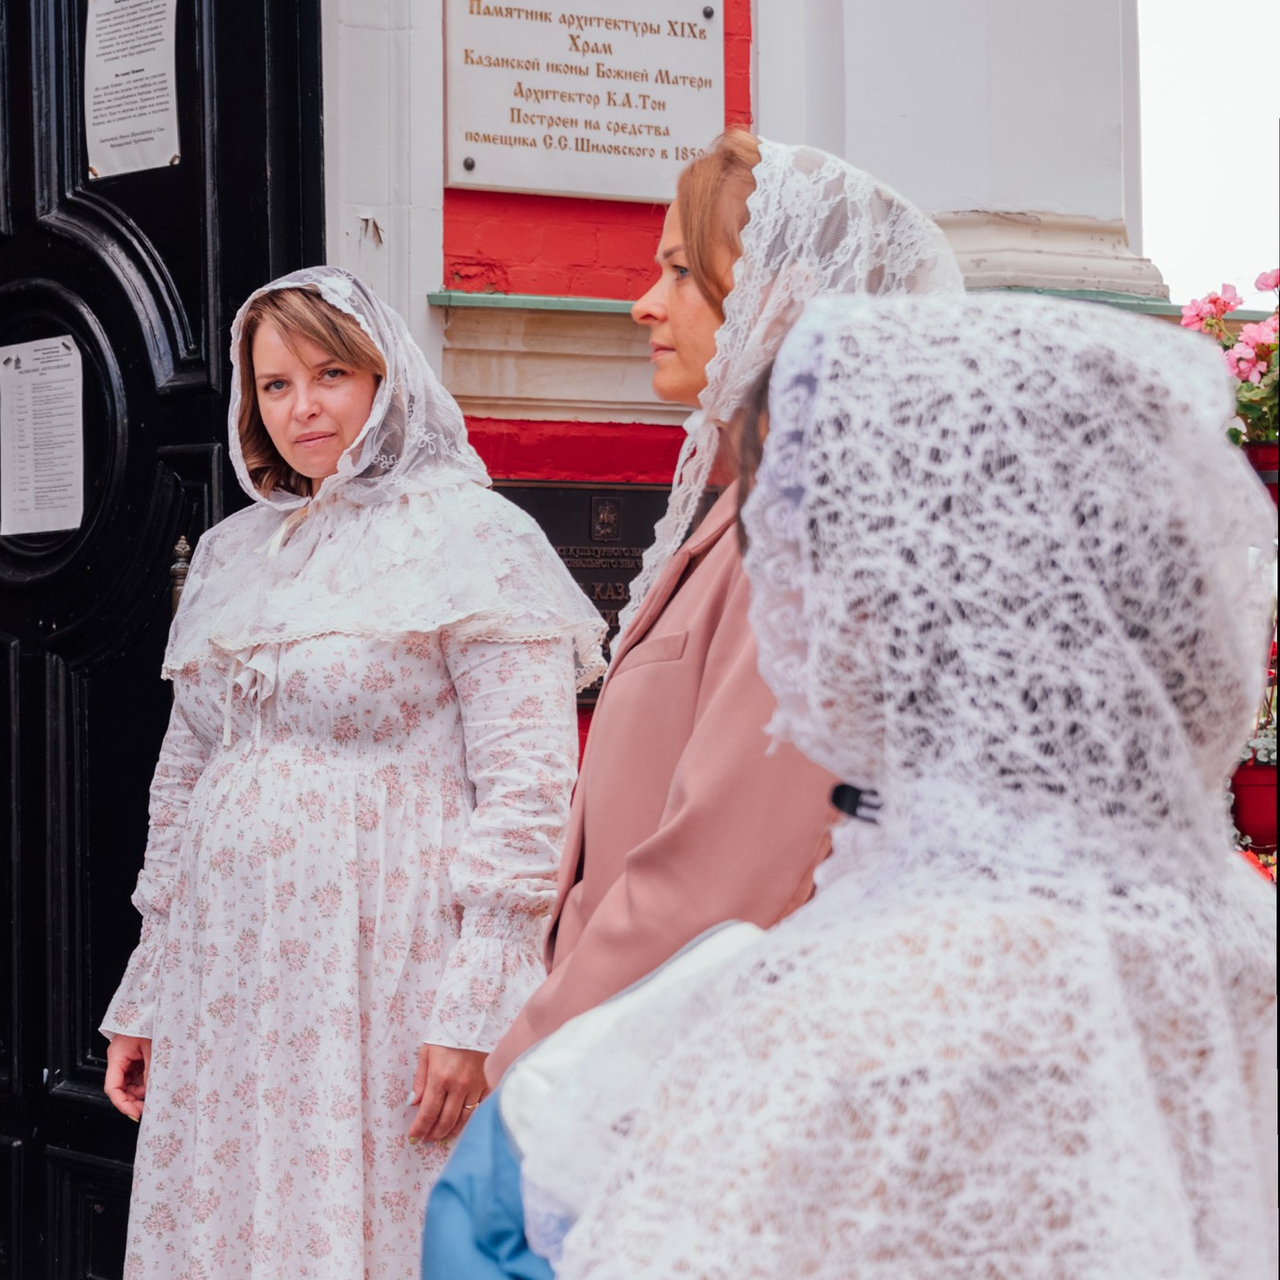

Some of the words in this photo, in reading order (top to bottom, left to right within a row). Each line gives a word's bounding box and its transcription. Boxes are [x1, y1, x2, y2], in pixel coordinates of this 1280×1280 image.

[558, 13, 660, 37] архитектуры
[568, 34, 613, 56] Храм
[463, 50, 540, 71] Казанской
[546, 61, 589, 77] иконы
[596, 63, 648, 82] Божией
[655, 69, 713, 90] Матери
[514, 82, 600, 108] Архитектор
[510, 108, 578, 130] Построен
[585, 119, 600, 131] на
[606, 121, 670, 138] средства
[465, 131, 537, 148] помещика
[661, 149, 668, 158] в
